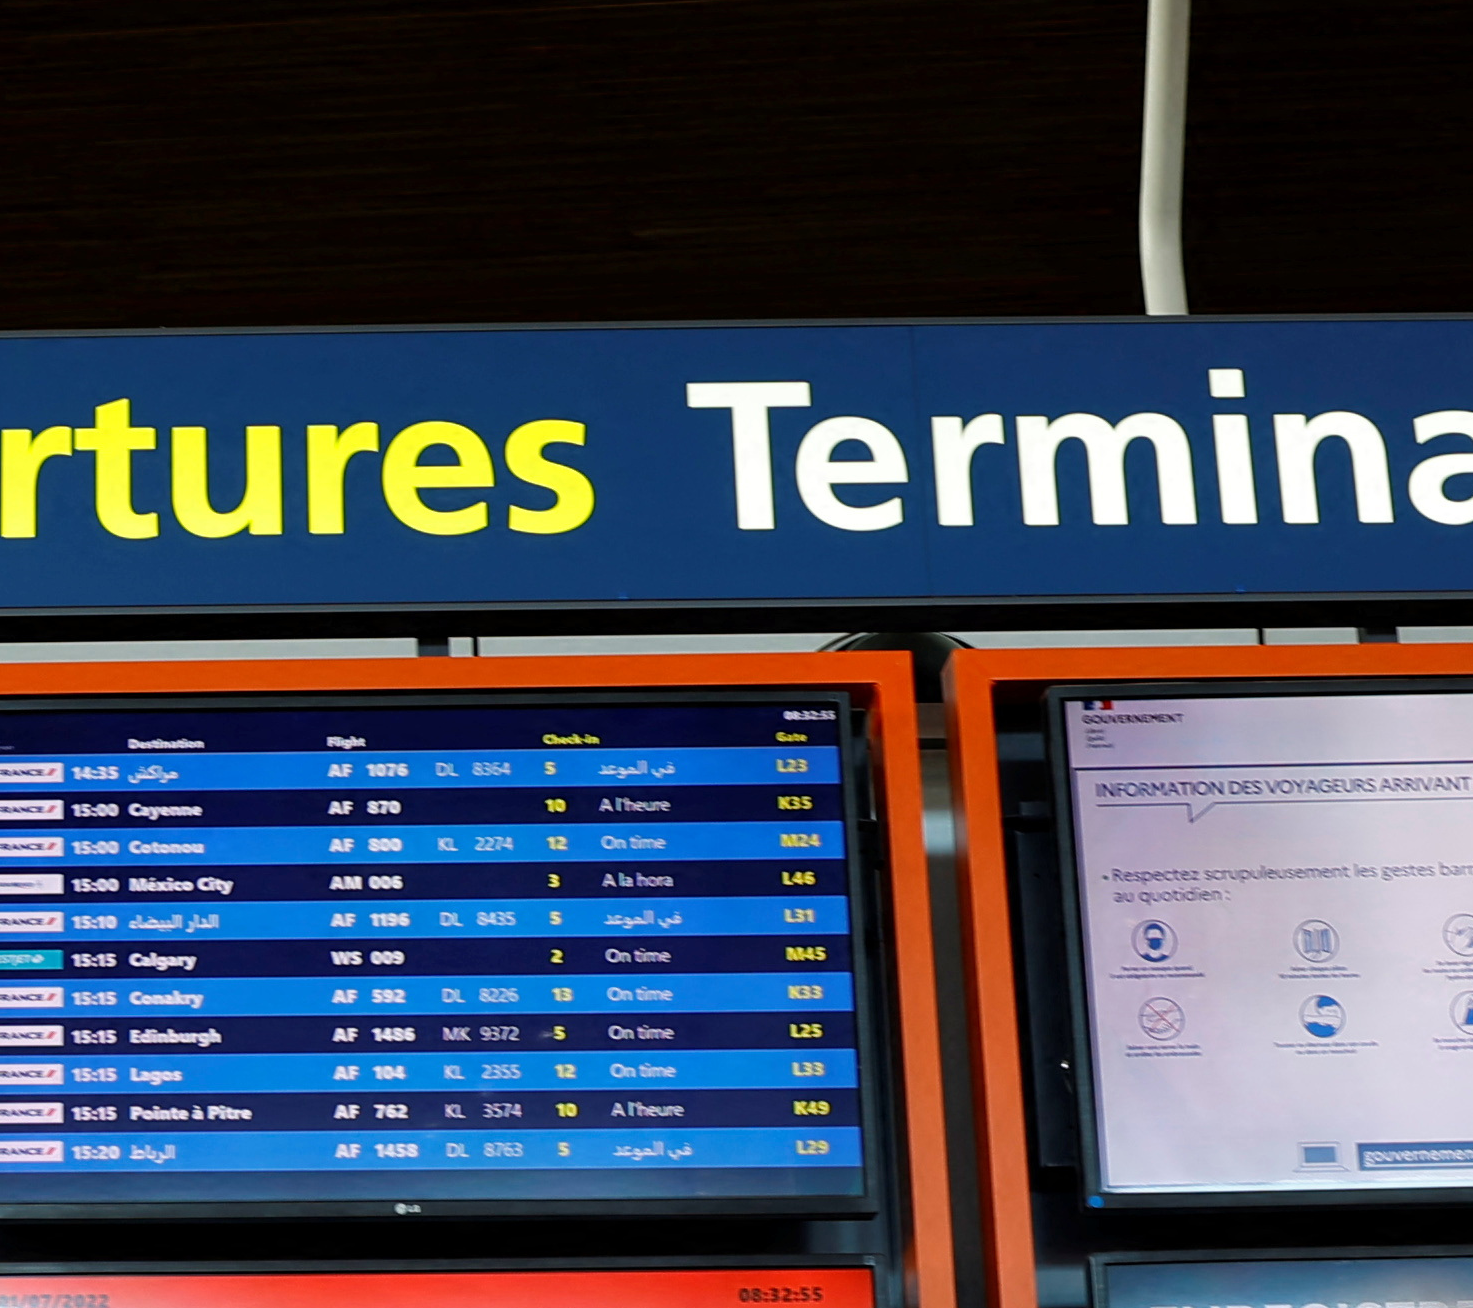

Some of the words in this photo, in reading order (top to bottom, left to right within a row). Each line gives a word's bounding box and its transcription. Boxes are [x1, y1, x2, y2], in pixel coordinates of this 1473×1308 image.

[1081, 712, 1185, 726] GOUVERNEMENT
[1095, 779, 1226, 798] INFORMATION
[1227, 779, 1265, 797] DES
[1265, 777, 1379, 796] VOYAGEURS
[1378, 775, 1473, 793] ARRIVANT
[70, 802, 120, 818] 15:00
[127, 801, 204, 821] Cayenne
[327, 799, 355, 816] AF
[365, 799, 402, 816] 870
[543, 798, 567, 814] 10
[598, 797, 615, 813] A
[614, 796, 672, 813] l'heure
[777, 795, 813, 811] K35
[1111, 867, 1201, 887] Respectez
[1203, 864, 1352, 884] scrupuleusement
[1353, 863, 1380, 880] les
[1379, 863, 1437, 882] gestes
[737, 1285, 824, 1304] 08:32:55
